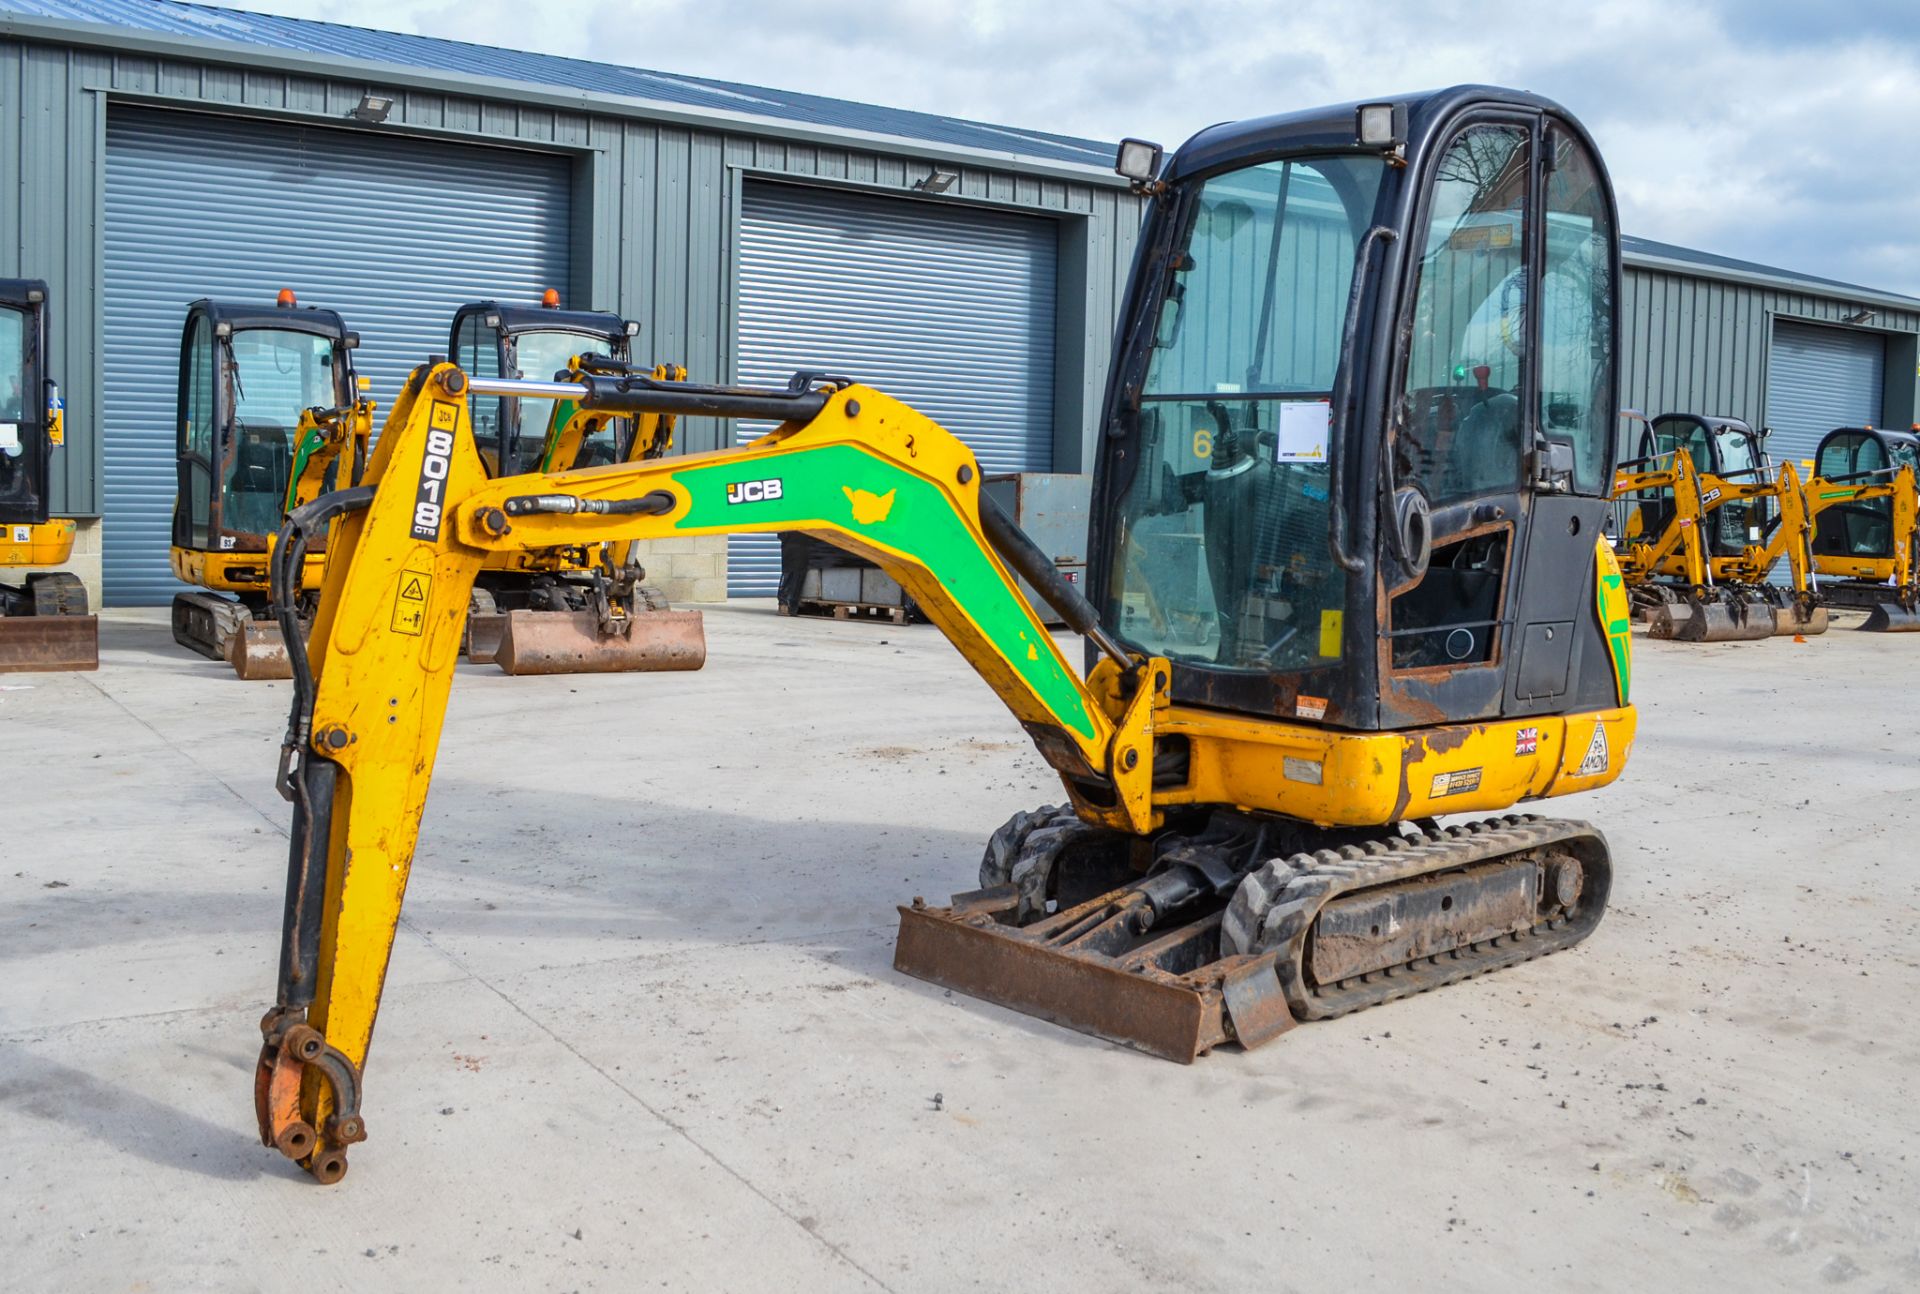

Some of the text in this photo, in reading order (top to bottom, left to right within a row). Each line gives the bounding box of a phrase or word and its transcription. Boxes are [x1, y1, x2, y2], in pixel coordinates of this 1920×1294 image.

[1193, 428, 1212, 460] 6
[414, 430, 454, 528] 8018
[727, 478, 783, 505] JCB
[1702, 488, 1721, 504] CB
